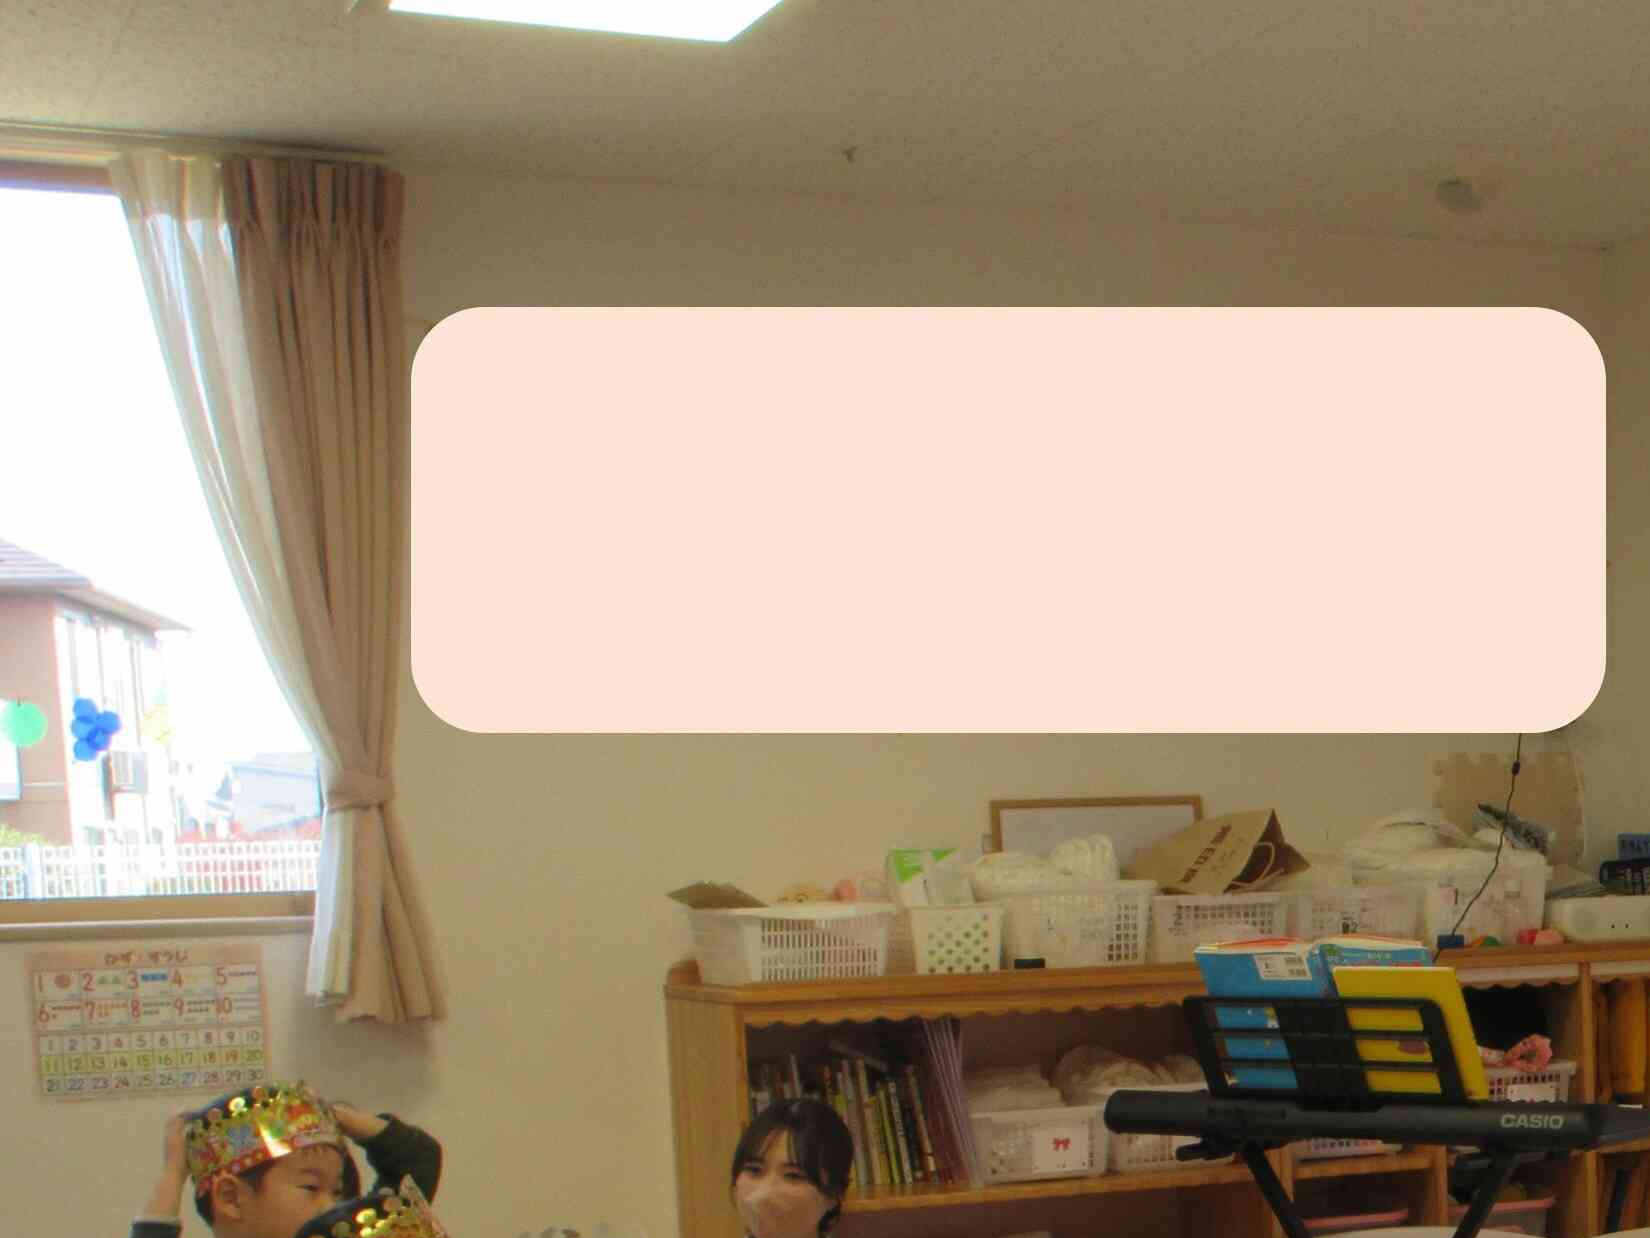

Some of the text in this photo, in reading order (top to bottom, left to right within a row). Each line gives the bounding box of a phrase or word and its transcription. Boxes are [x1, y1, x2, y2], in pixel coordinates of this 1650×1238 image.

[216, 997, 232, 1014] 10
[246, 1030, 260, 1041] 10
[44, 1049, 262, 1072] 11 12 13 14 15 16 17 18 19 20
[47, 1069, 263, 1092] 21 22 23 24 25 26 27 28 29 30
[1501, 1113, 1564, 1129] CASIO
